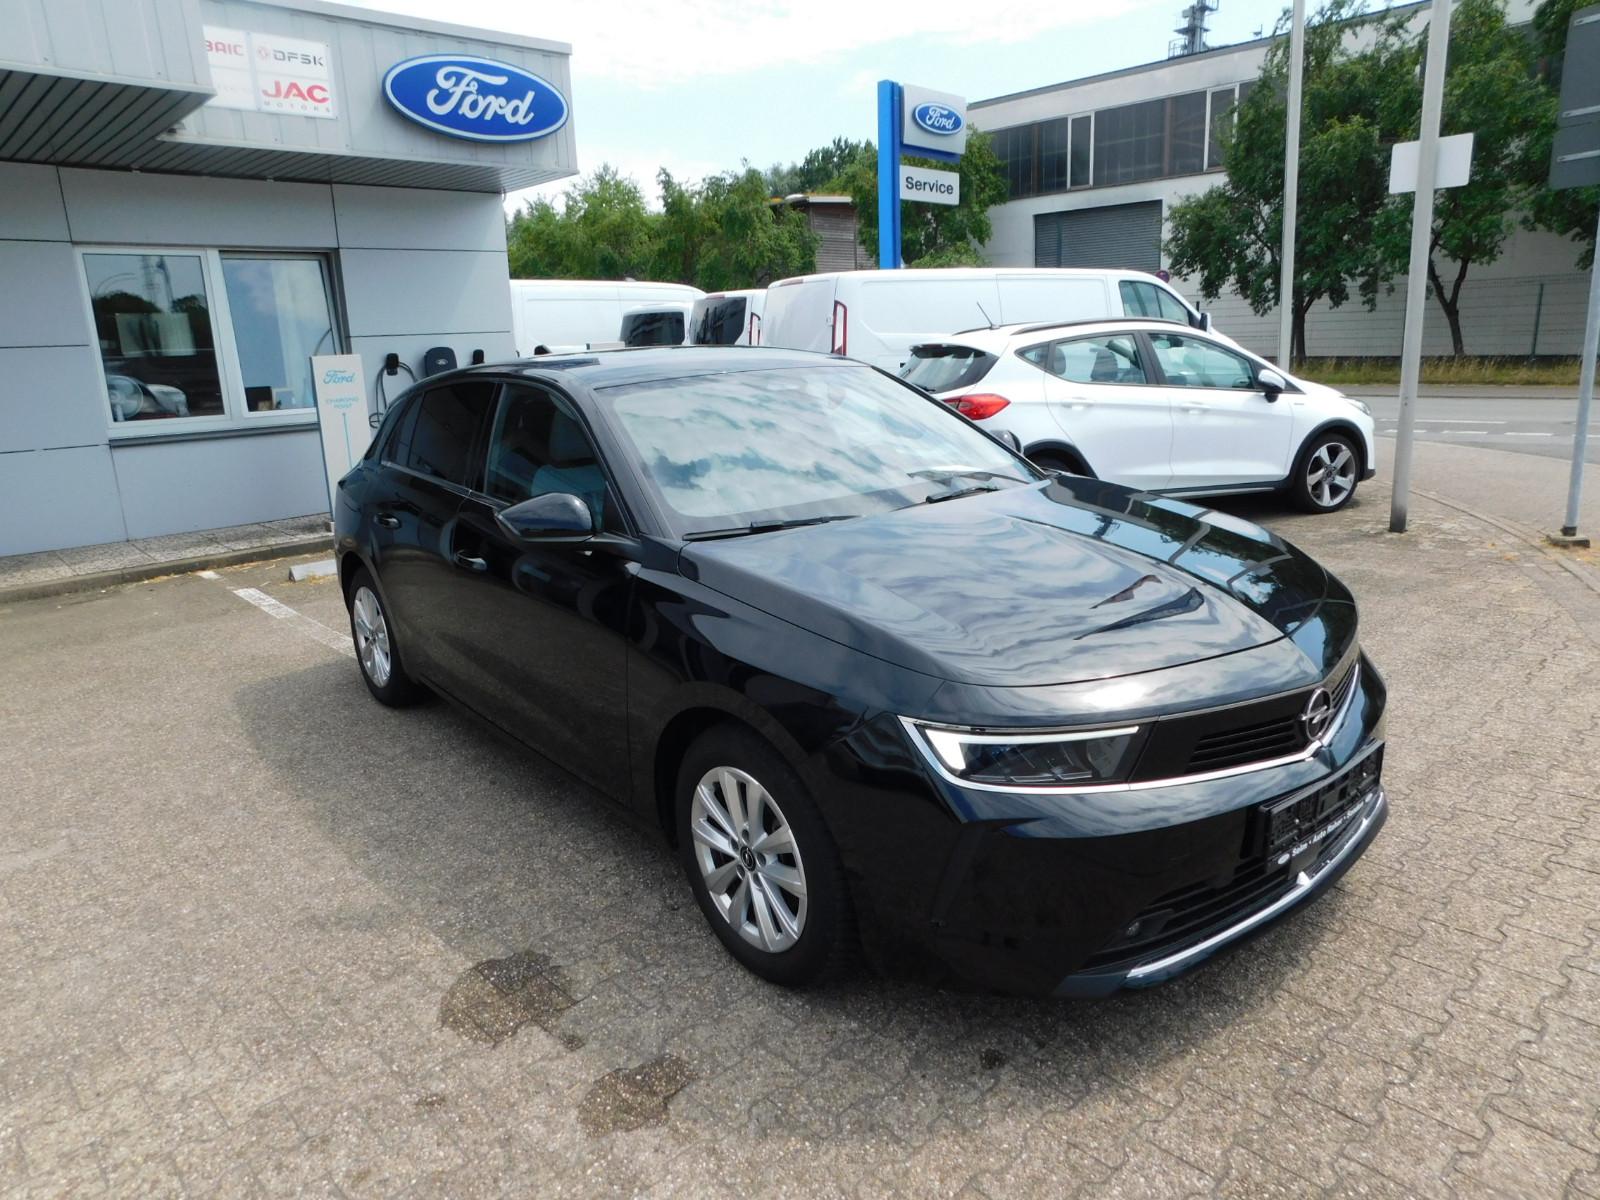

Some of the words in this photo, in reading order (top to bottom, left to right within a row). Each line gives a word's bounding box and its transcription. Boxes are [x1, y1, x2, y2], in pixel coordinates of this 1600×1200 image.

[262, 80, 330, 104] JAC
[426, 66, 535, 126] Ford
[926, 106, 956, 129] Ford
[905, 176, 954, 195] Service
[323, 370, 356, 384] Ford
